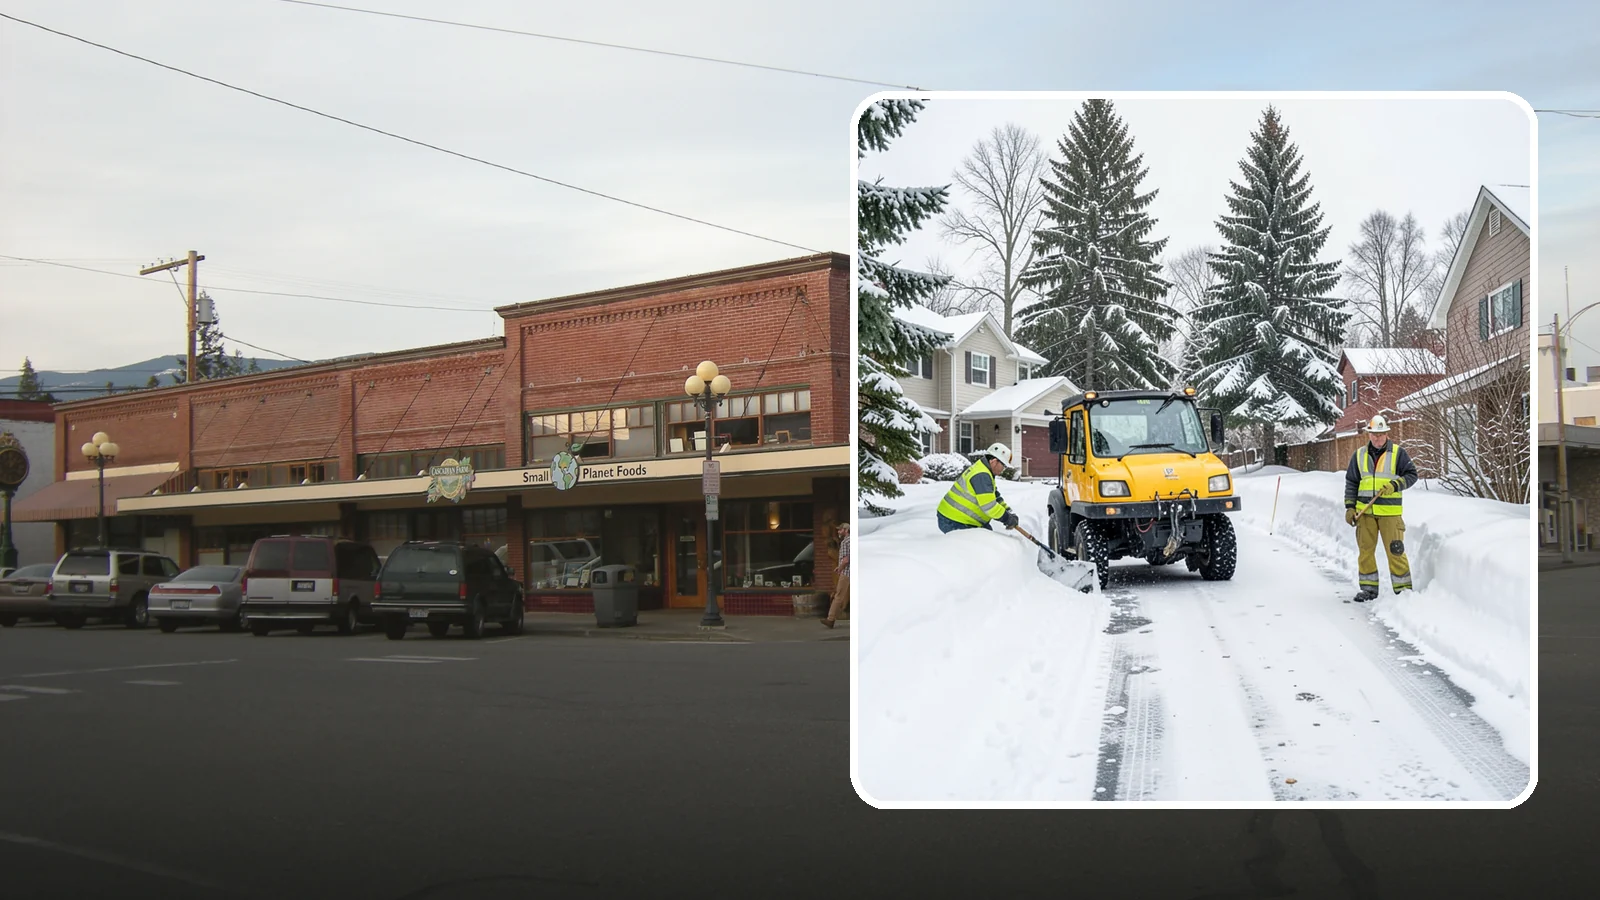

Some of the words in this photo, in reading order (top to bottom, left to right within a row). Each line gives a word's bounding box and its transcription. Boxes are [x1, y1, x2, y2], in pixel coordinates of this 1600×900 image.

[523, 471, 549, 483] Small
[582, 467, 614, 479] Planet
[616, 464, 647, 477] Foods
